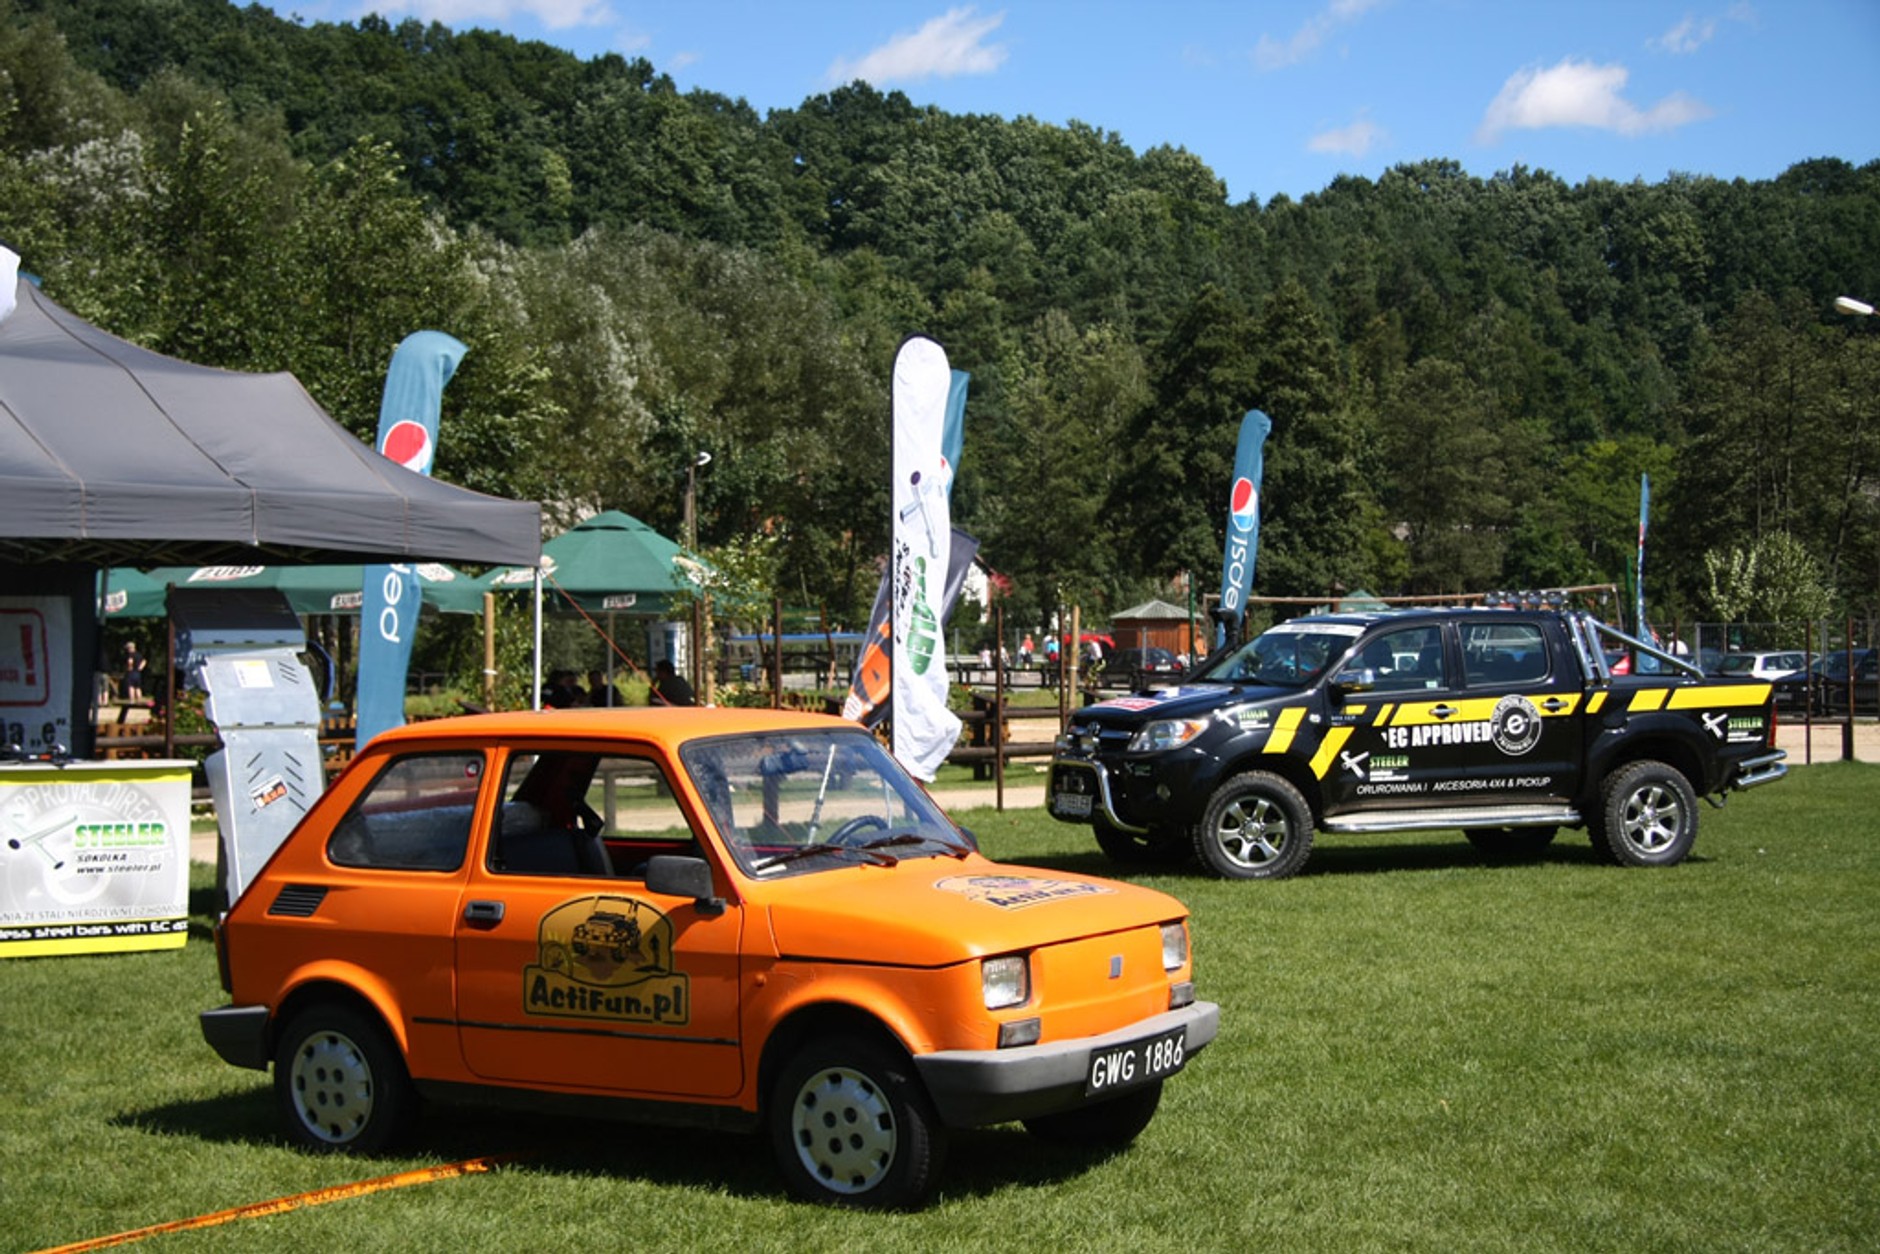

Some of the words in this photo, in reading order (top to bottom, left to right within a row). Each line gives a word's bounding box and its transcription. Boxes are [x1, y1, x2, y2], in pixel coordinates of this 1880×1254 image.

[1411, 720, 1492, 747] APPROVED
[1432, 780, 1488, 791] AKCESORIA
[1507, 778, 1514, 788] &
[1515, 776, 1551, 788] PICKUP
[75, 822, 165, 848] STEELER
[530, 973, 682, 1022] ActiFun.pl
[1091, 1050, 1136, 1089] GWG
[1144, 1034, 1185, 1076] 1886
